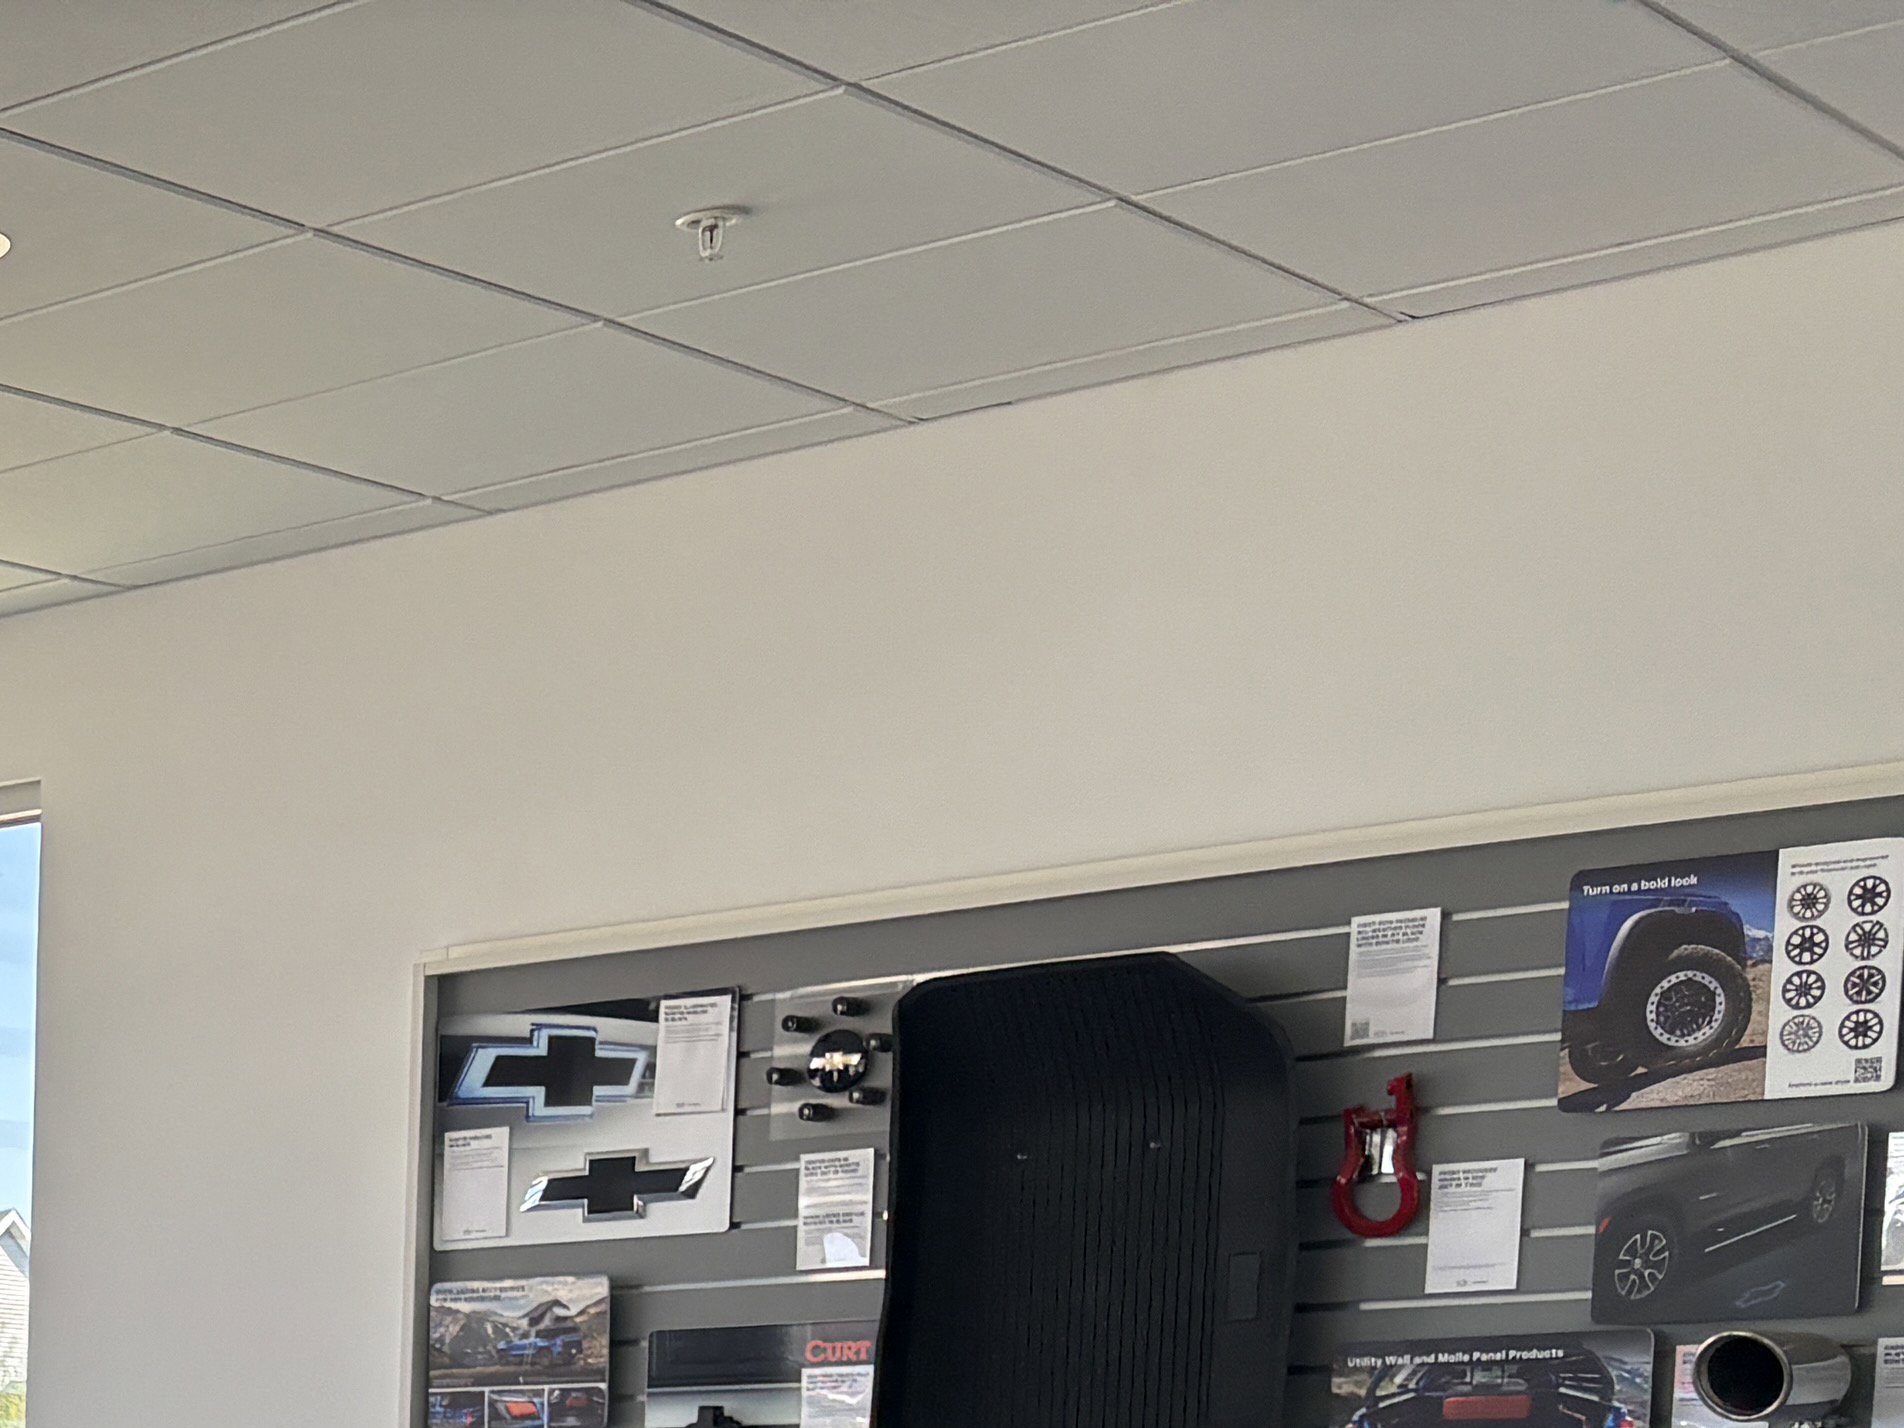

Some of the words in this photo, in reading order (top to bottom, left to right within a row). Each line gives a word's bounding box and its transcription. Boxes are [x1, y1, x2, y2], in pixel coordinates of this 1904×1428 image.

[1582, 885, 1610, 896] Turn
[1612, 883, 1628, 893] on
[1630, 882, 1639, 892] a
[1640, 877, 1669, 890] bold
[1670, 874, 1698, 887] look
[804, 1339, 873, 1364] CURT
[1347, 1356, 1383, 1368] Utility
[1384, 1354, 1411, 1366] Wall
[1412, 1353, 1436, 1365] and
[1472, 1349, 1507, 1362] Panel
[1508, 1348, 1564, 1360] Products
